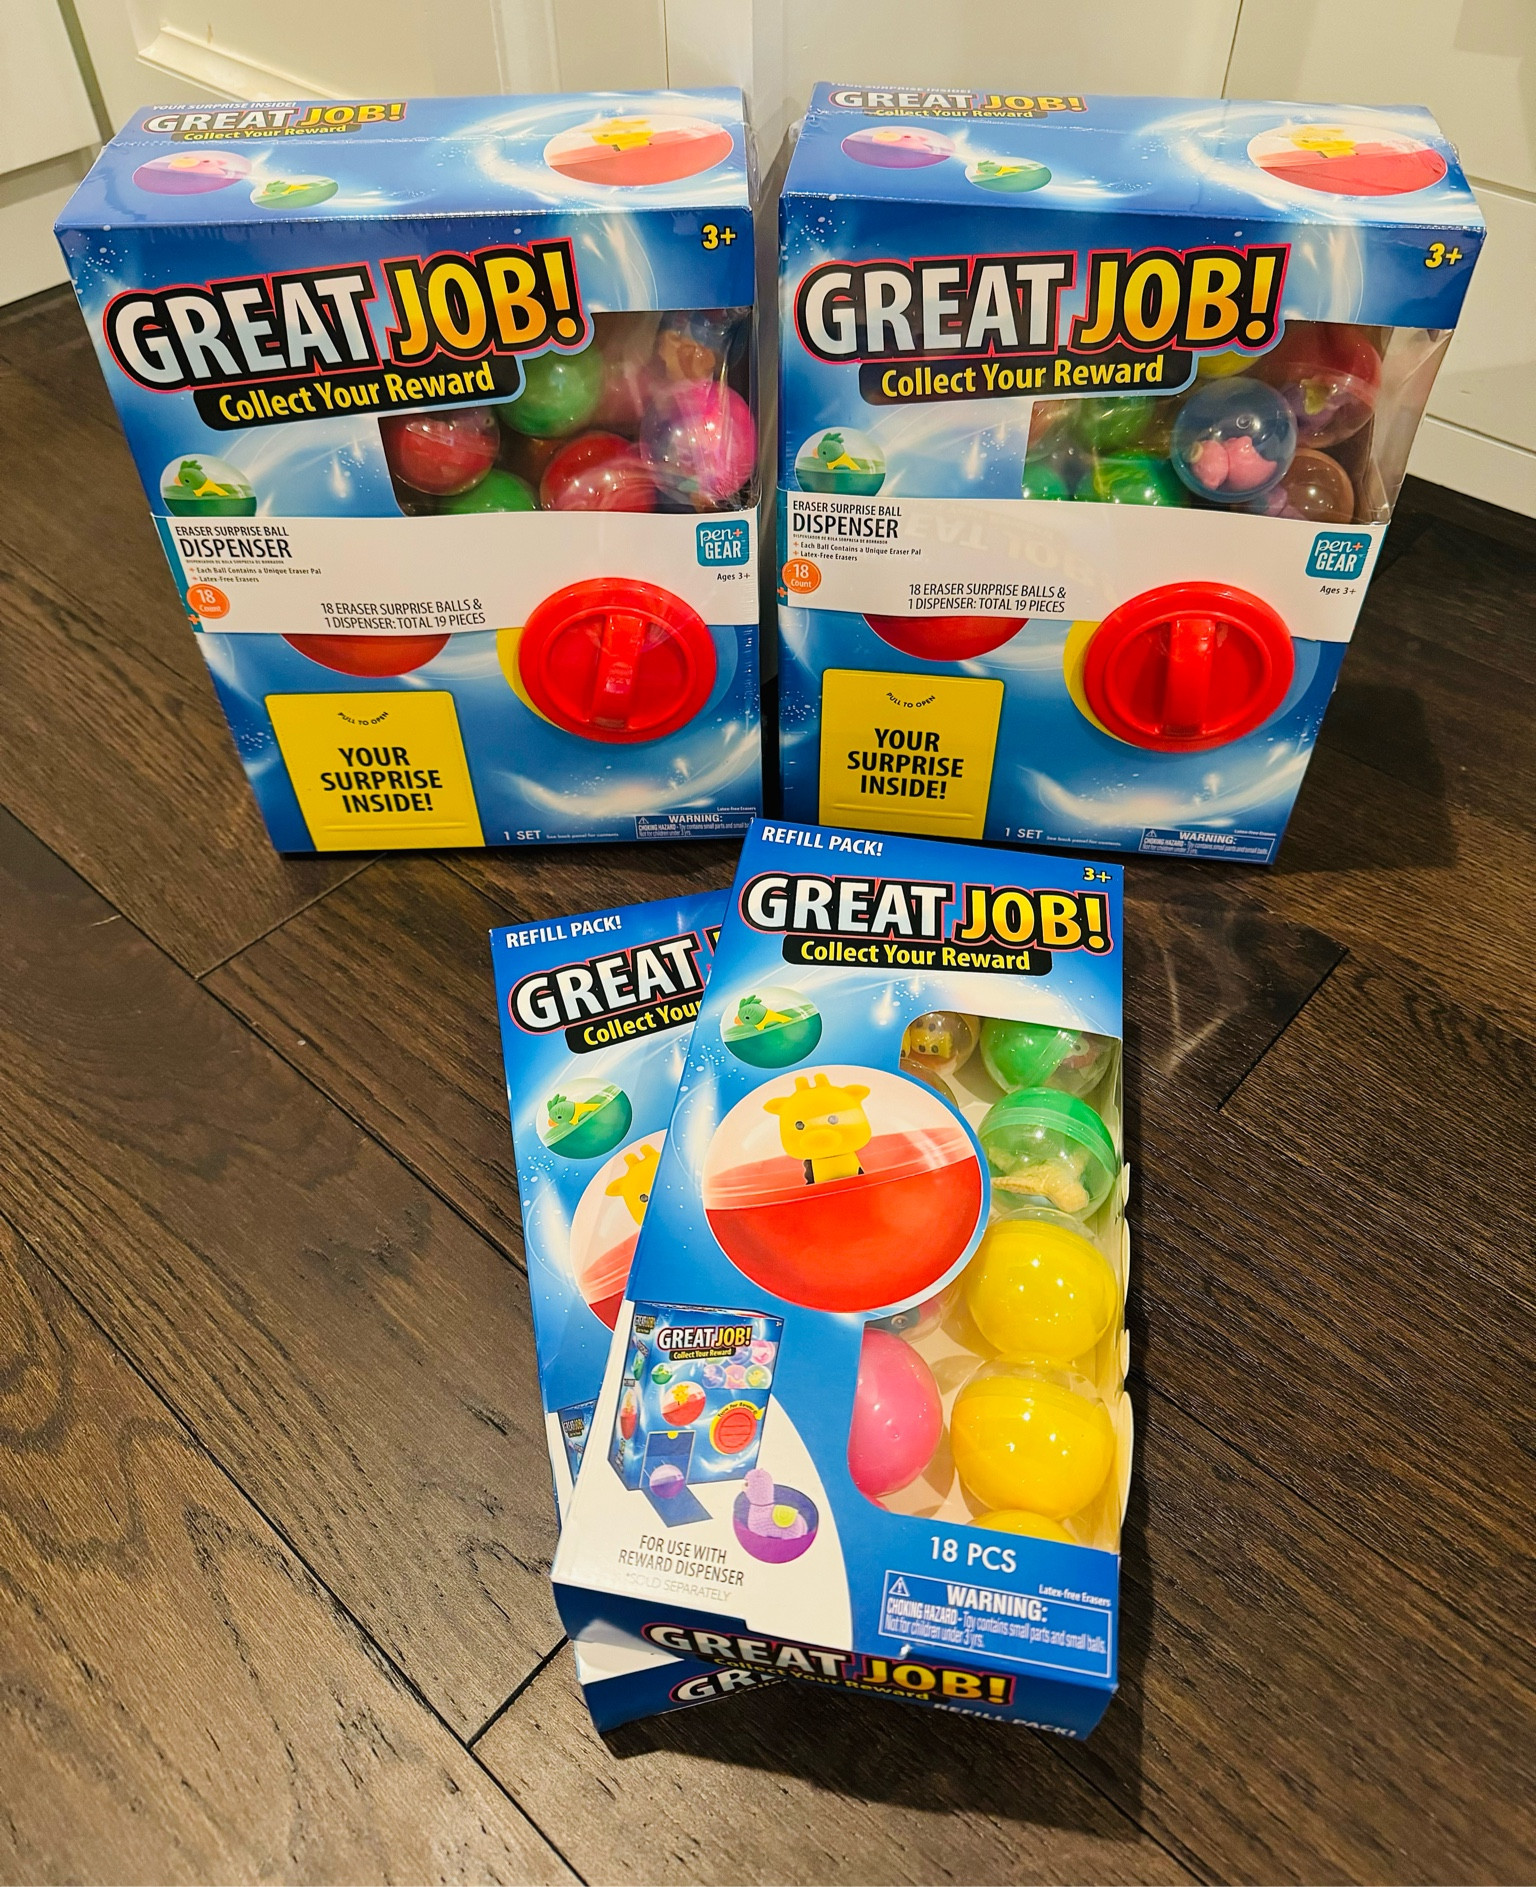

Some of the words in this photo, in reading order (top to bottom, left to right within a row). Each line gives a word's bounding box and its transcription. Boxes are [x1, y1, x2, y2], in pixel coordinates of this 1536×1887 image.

[834, 91, 972, 109] GREAT
[984, 94, 1085, 112] JOB!
[147, 109, 296, 131] GREAT
[300, 103, 403, 126] JOB!
[875, 109, 930, 117] Collect
[932, 109, 970, 117] Your
[972, 110, 1033, 118] Reward
[184, 130, 242, 141] Collect
[243, 129, 280, 138] Your
[284, 125, 347, 136] Reward
[701, 223, 738, 251] 3+
[1425, 243, 1464, 270] 3+
[803, 260, 1067, 355] GREAT
[1078, 251, 1281, 348] JOB!
[112, 273, 370, 386] GREAT
[389, 250, 578, 357] JOB!
[880, 365, 979, 399] Collect
[981, 361, 1050, 392] Your
[1053, 353, 1165, 388] Reward
[218, 385, 315, 423] Collect
[318, 378, 387, 413] Your
[390, 360, 496, 400] Reward
[793, 500, 828, 513] ERASER
[830, 503, 876, 515] SURPRISE
[878, 506, 902, 516] BALL
[175, 526, 214, 537] ERASER
[214, 526, 261, 537] SURPRISE
[263, 526, 289, 537] BALL
[793, 513, 898, 538] DISPENSER
[179, 538, 293, 558] DISPENSER
[705, 540, 741, 559] GEAR
[800, 551, 833, 559] Latex-Free
[865, 547, 887, 555] Unique
[263, 567, 287, 575] Unique
[793, 564, 809, 579] 18
[1315, 552, 1357, 572] GEAR
[717, 573, 736, 582] Ages
[738, 572, 750, 580] 3+
[790, 579, 811, 587] Count
[196, 589, 216, 604] 18
[909, 584, 921, 595] 18
[923, 583, 964, 596] ERASER
[966, 583, 1018, 596] SURPRISE
[1020, 585, 1055, 598] BALLS
[1057, 587, 1066, 598] &
[1320, 585, 1340, 595] Ages
[1343, 587, 1356, 595] 3+
[321, 602, 334, 615] 18
[336, 602, 378, 615] ERASER
[379, 602, 434, 615] SURPRISE
[436, 599, 471, 613] BALLS
[473, 598, 482, 610] &
[908, 599, 913, 609] 1
[915, 597, 976, 610] DISPENSER:
[979, 598, 1012, 610] TOTAL
[1014, 600, 1026, 611] 19
[1028, 600, 1065, 613] PIECES
[325, 617, 331, 628] 1
[333, 616, 396, 629] DISPENSER:
[398, 616, 433, 629] TOTAL
[434, 616, 447, 628] 19
[449, 612, 486, 626] PIECES
[886, 692, 900, 706] PULL
[916, 695, 936, 708] OPEN
[337, 712, 355, 724] PULL
[370, 711, 389, 724] OPEN
[874, 728, 940, 752] YOUR
[337, 746, 411, 767] YOUR
[847, 751, 964, 778] SURPRISE
[320, 769, 443, 791] SURPRISE
[860, 775, 947, 799] INSIDE!
[341, 793, 434, 813] INSIDE!
[668, 814, 723, 823] WARNING:
[504, 831, 510, 840] 1
[516, 830, 541, 840] SET
[761, 826, 824, 850] REFILL
[828, 835, 884, 857] PACK!
[1005, 827, 1010, 837] 1
[1016, 828, 1043, 840] SET
[1180, 831, 1237, 845] WARNING:
[1083, 867, 1112, 884] 3+
[747, 877, 948, 938] GREAT
[961, 888, 1106, 949] JOB!
[506, 924, 567, 948] REFILL
[571, 915, 622, 938] PACK!
[800, 940, 879, 964] Collect
[884, 944, 936, 967] Your
[942, 947, 1031, 971] Reward
[516, 938, 698, 1029] GREAT
[583, 1011, 654, 1046] Collect
[659, 1328, 715, 1349] GREAT
[716, 1326, 751, 1346] JOB!
[674, 1351, 695, 1359] Collect
[640, 1535, 664, 1552] FOR
[667, 1540, 691, 1557] USE
[693, 1544, 727, 1564] WITH
[931, 1536, 958, 1563] 18
[967, 1543, 1017, 1573] PCS
[618, 1549, 673, 1572] REWARD
[675, 1560, 745, 1586] DISPENSER
[664, 1580, 731, 1601] SEPARATELY
[1039, 1584, 1080, 1600] Latex-free
[1082, 1592, 1111, 1607] Erasers
[947, 1585, 1048, 1622] WARNING:
[885, 1614, 897, 1631] Not
[899, 1617, 910, 1634] for
[911, 1620, 940, 1639] children
[941, 1627, 963, 1643] under
[963, 1629, 969, 1645] 3
[970, 1633, 985, 1650] yrs.
[887, 1598, 923, 1619] CHOKING
[963, 1611, 976, 1632] Toy
[977, 1616, 1008, 1635] contains
[1009, 1622, 1029, 1639] small
[1030, 1626, 1050, 1644] parts
[1051, 1630, 1066, 1646] and
[1066, 1633, 1086, 1650] small
[1087, 1634, 1107, 1654] balls.
[650, 1625, 847, 1677] GREAT
[863, 1660, 1007, 1704] JOB!
[714, 1658, 787, 1676] Collect
[789, 1670, 839, 1684] Your
[845, 1679, 930, 1700] Reward
[934, 1703, 1005, 1722] REFILL
[1012, 1719, 1078, 1737] PACK!
